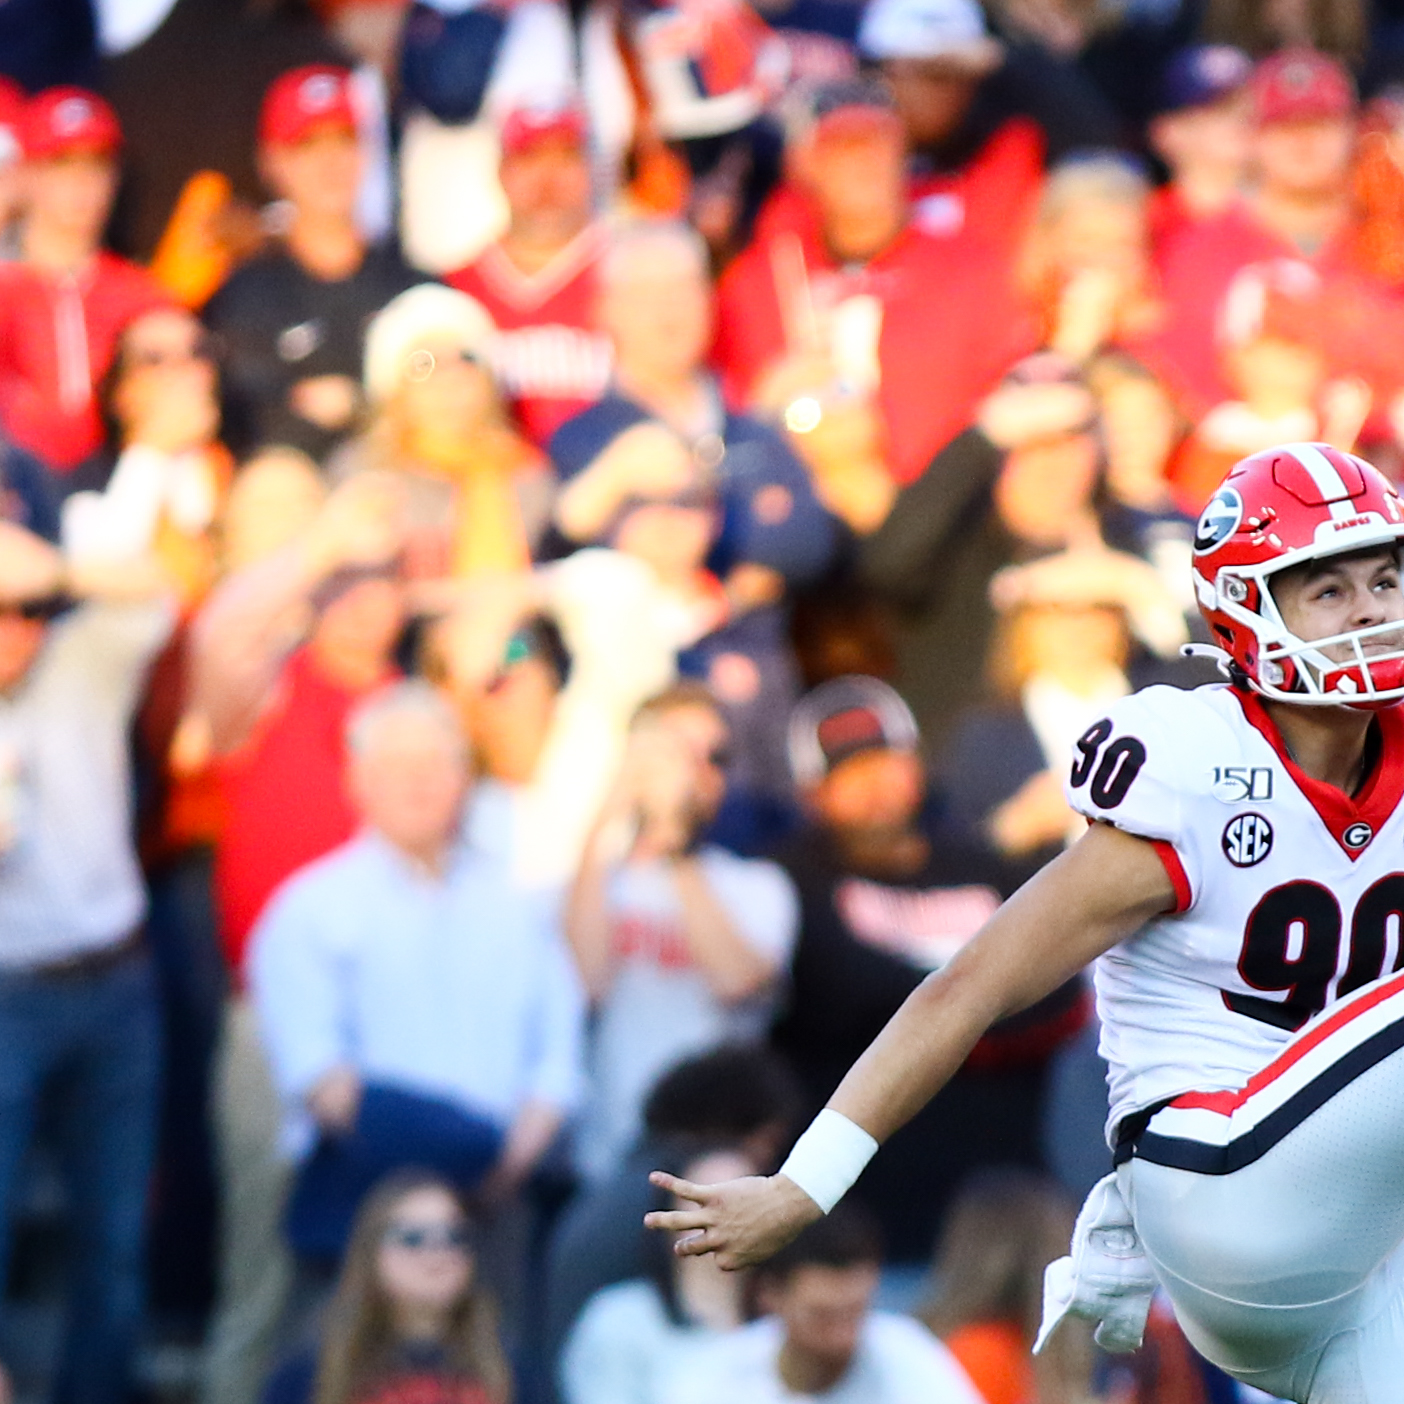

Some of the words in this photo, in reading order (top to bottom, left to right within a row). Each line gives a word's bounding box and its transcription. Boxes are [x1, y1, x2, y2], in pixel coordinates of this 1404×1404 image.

[1071, 717, 1146, 810] 90
[1211, 766, 1274, 802] 150
[1224, 813, 1273, 866] SEC
[1342, 822, 1373, 849] G
